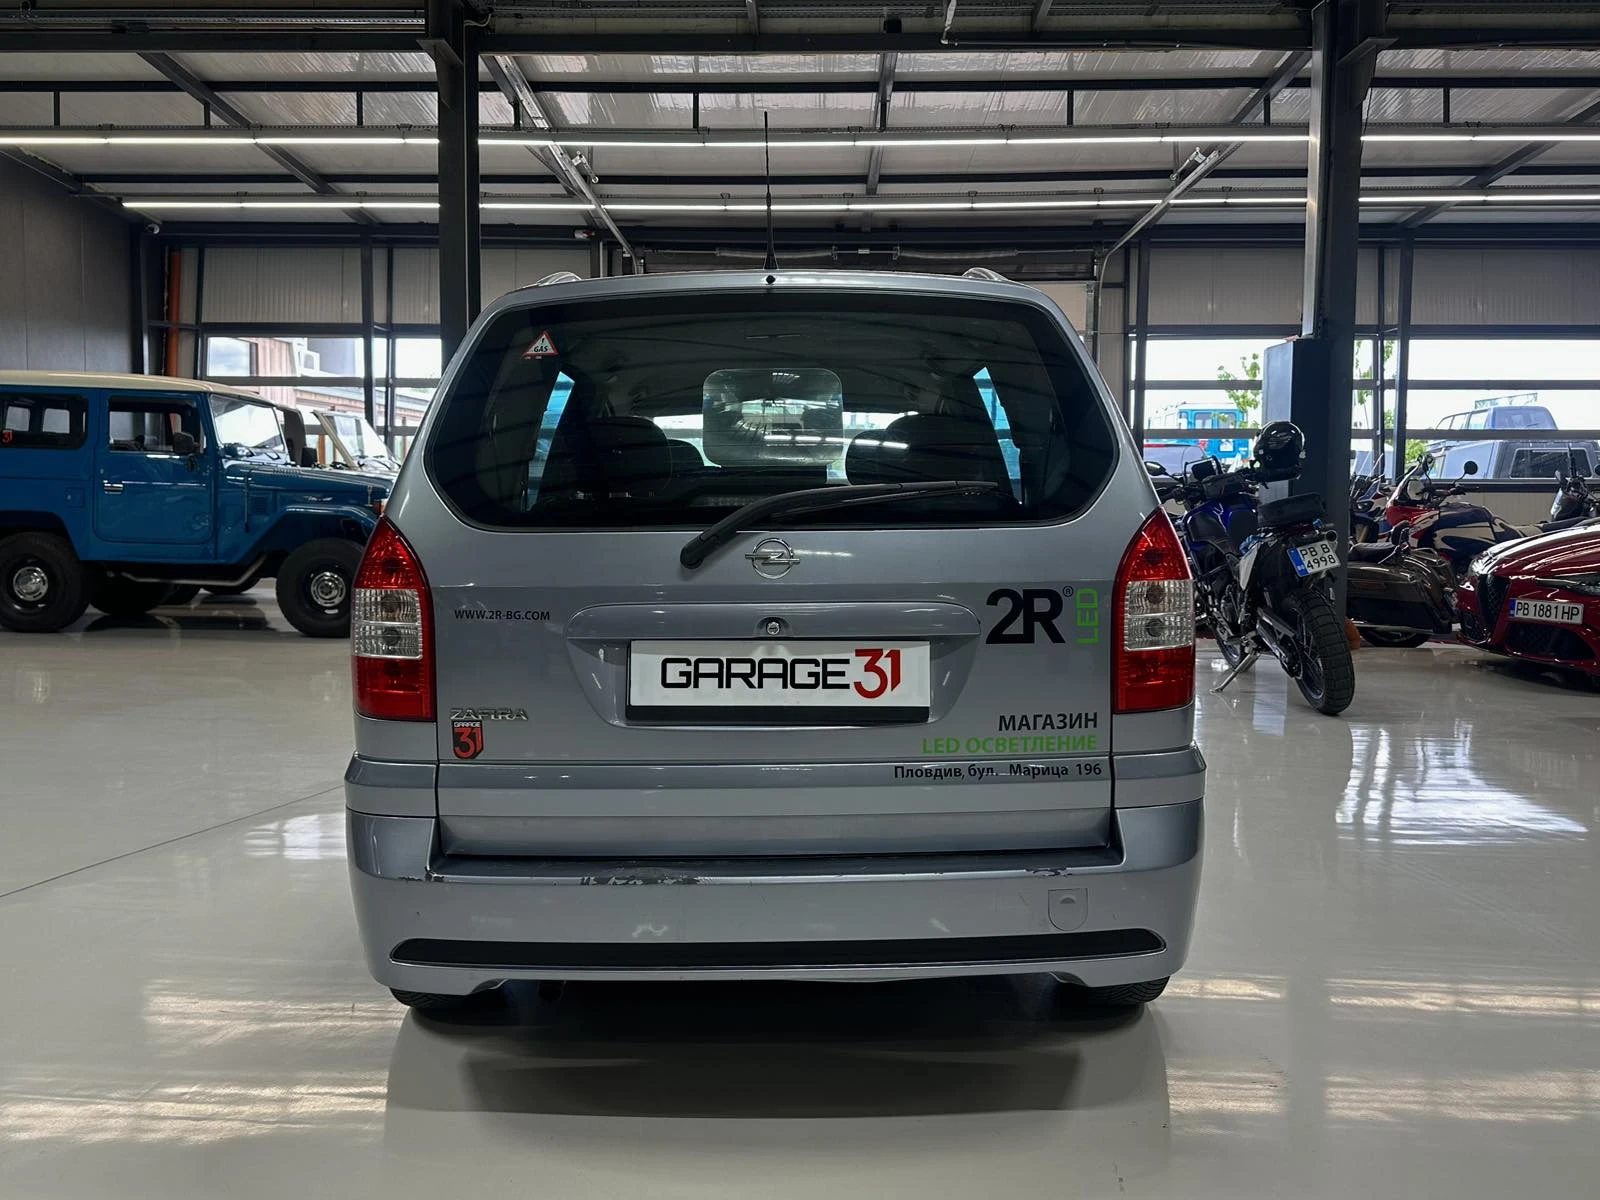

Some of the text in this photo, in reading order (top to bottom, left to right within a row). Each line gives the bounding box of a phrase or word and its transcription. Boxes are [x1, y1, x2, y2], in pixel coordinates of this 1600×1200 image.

[1300, 544, 1331, 559] PB B
[1306, 554, 1336, 570] 4998
[454, 609, 550, 620] WWW.2R-BG.COM
[1076, 588, 1098, 644] LED
[1516, 602, 1580, 620] PB 1881 HP
[450, 708, 528, 720] ZAFIRA
[998, 712, 1098, 731] МАГАЗИН
[454, 727, 482, 758] 31
[922, 734, 1097, 754] LED ОСВЕТЛЕНИЕ
[894, 765, 965, 780] Пловдив,
[1009, 763, 1069, 778] Марица
[1075, 763, 1102, 775] 196
